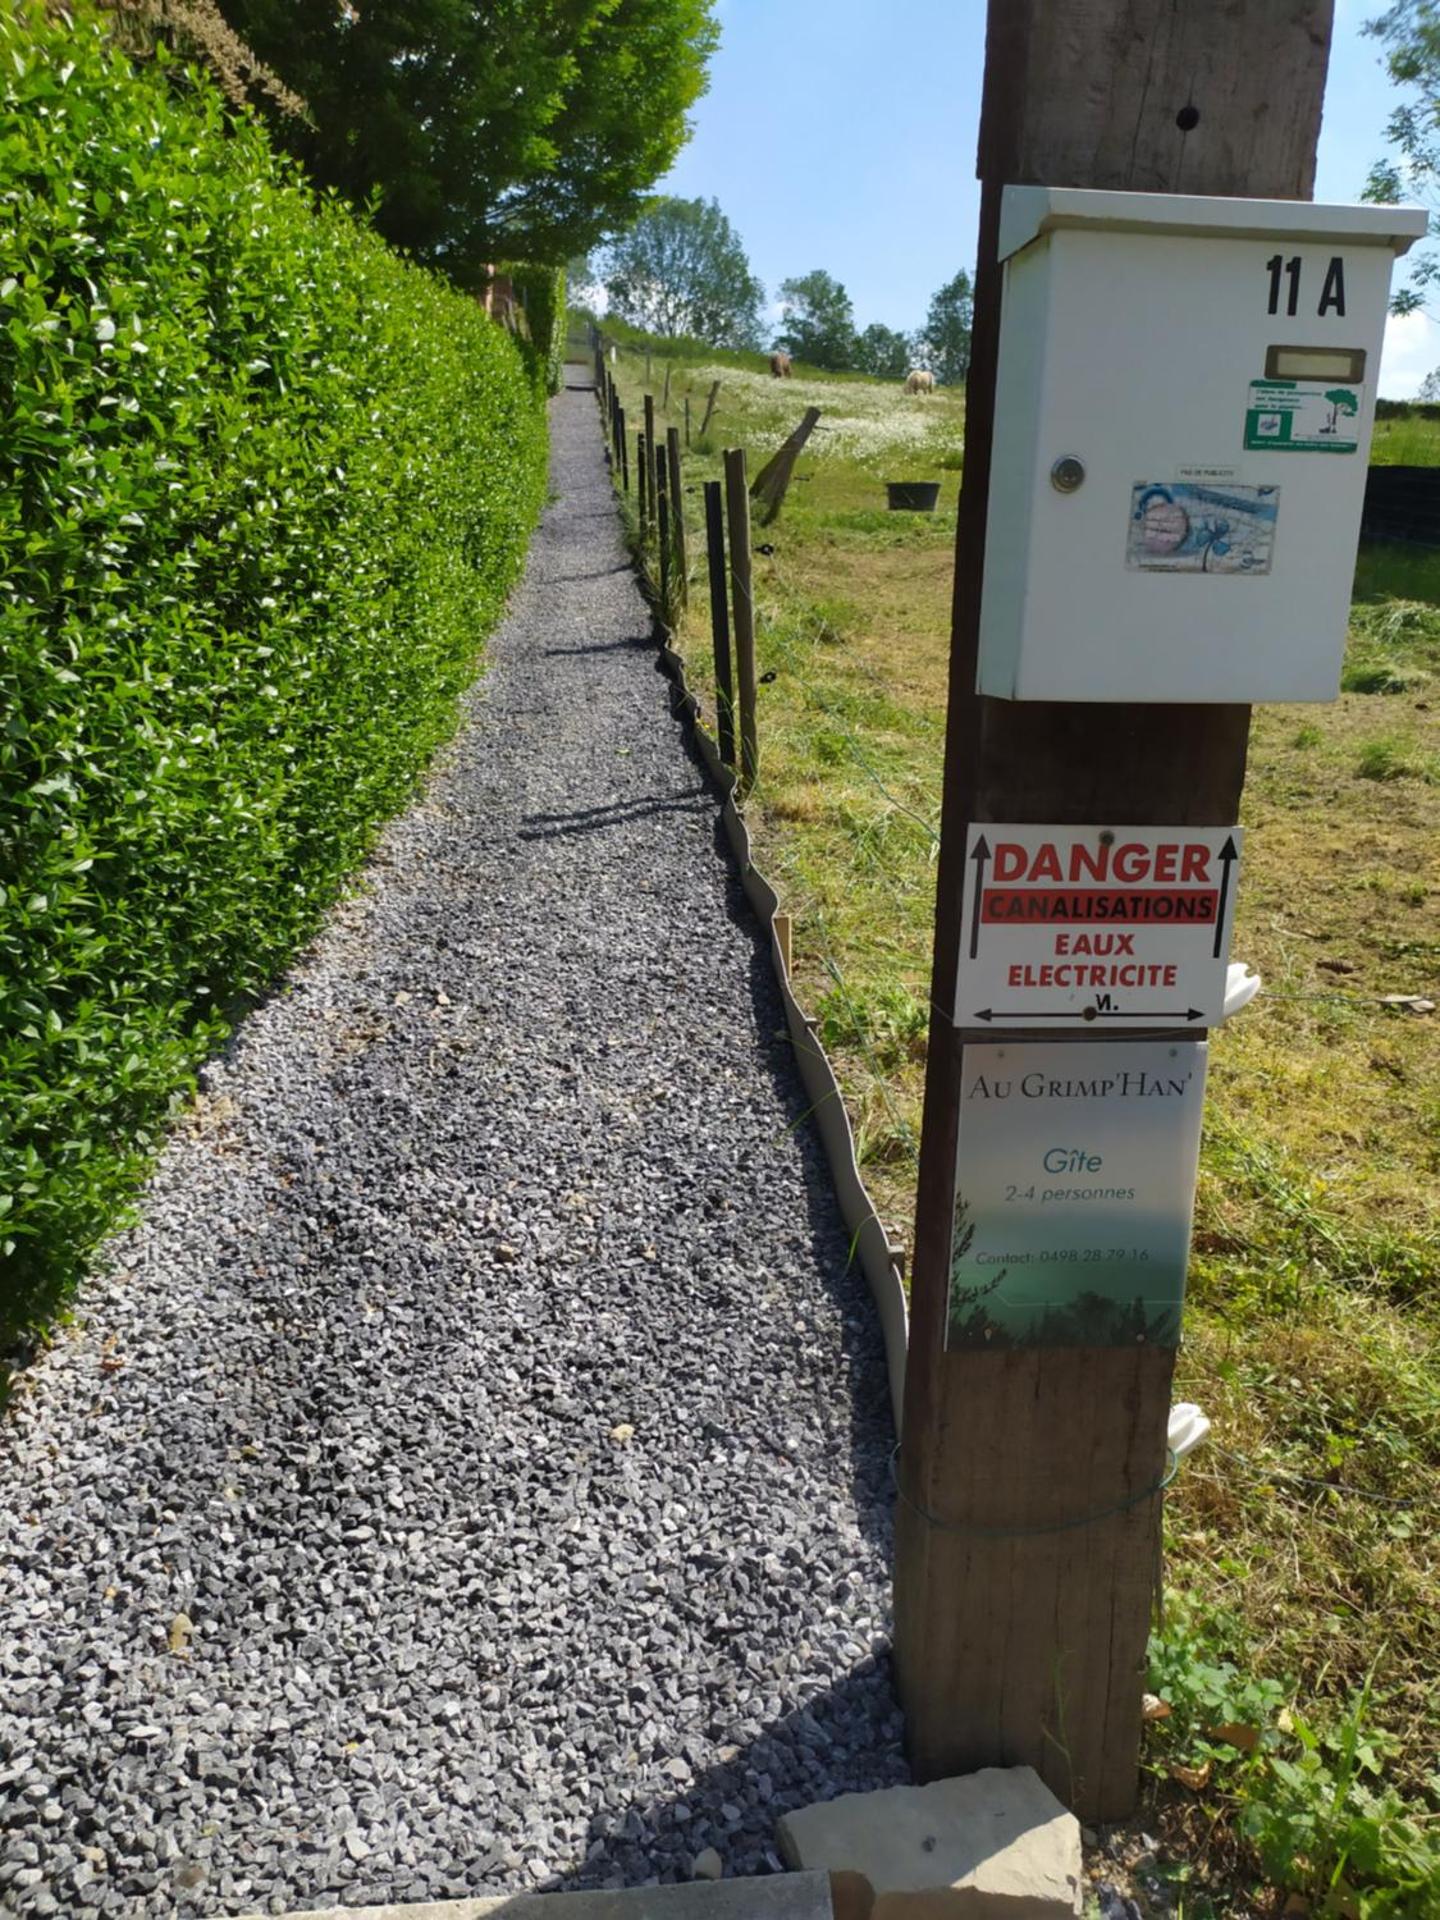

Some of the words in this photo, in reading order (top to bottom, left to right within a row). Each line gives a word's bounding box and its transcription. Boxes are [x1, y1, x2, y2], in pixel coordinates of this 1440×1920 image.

[1266, 255, 1302, 315] 11
[1317, 257, 1346, 317] A
[992, 843, 1212, 883] DANGER
[988, 895, 1213, 919] CANALISATIONS
[1054, 933, 1135, 956] EAUX
[1008, 965, 1178, 987] ELECTRICITE
[1043, 1148, 1102, 1173] Gîte
[1004, 1186, 1035, 1202] 2-4
[1040, 1186, 1136, 1205] personnes
[975, 1252, 1035, 1266] Contact:
[1039, 1250, 1078, 1264] 0498
[1083, 1249, 1102, 1263] 28
[1129, 1248, 1150, 1262] 16
